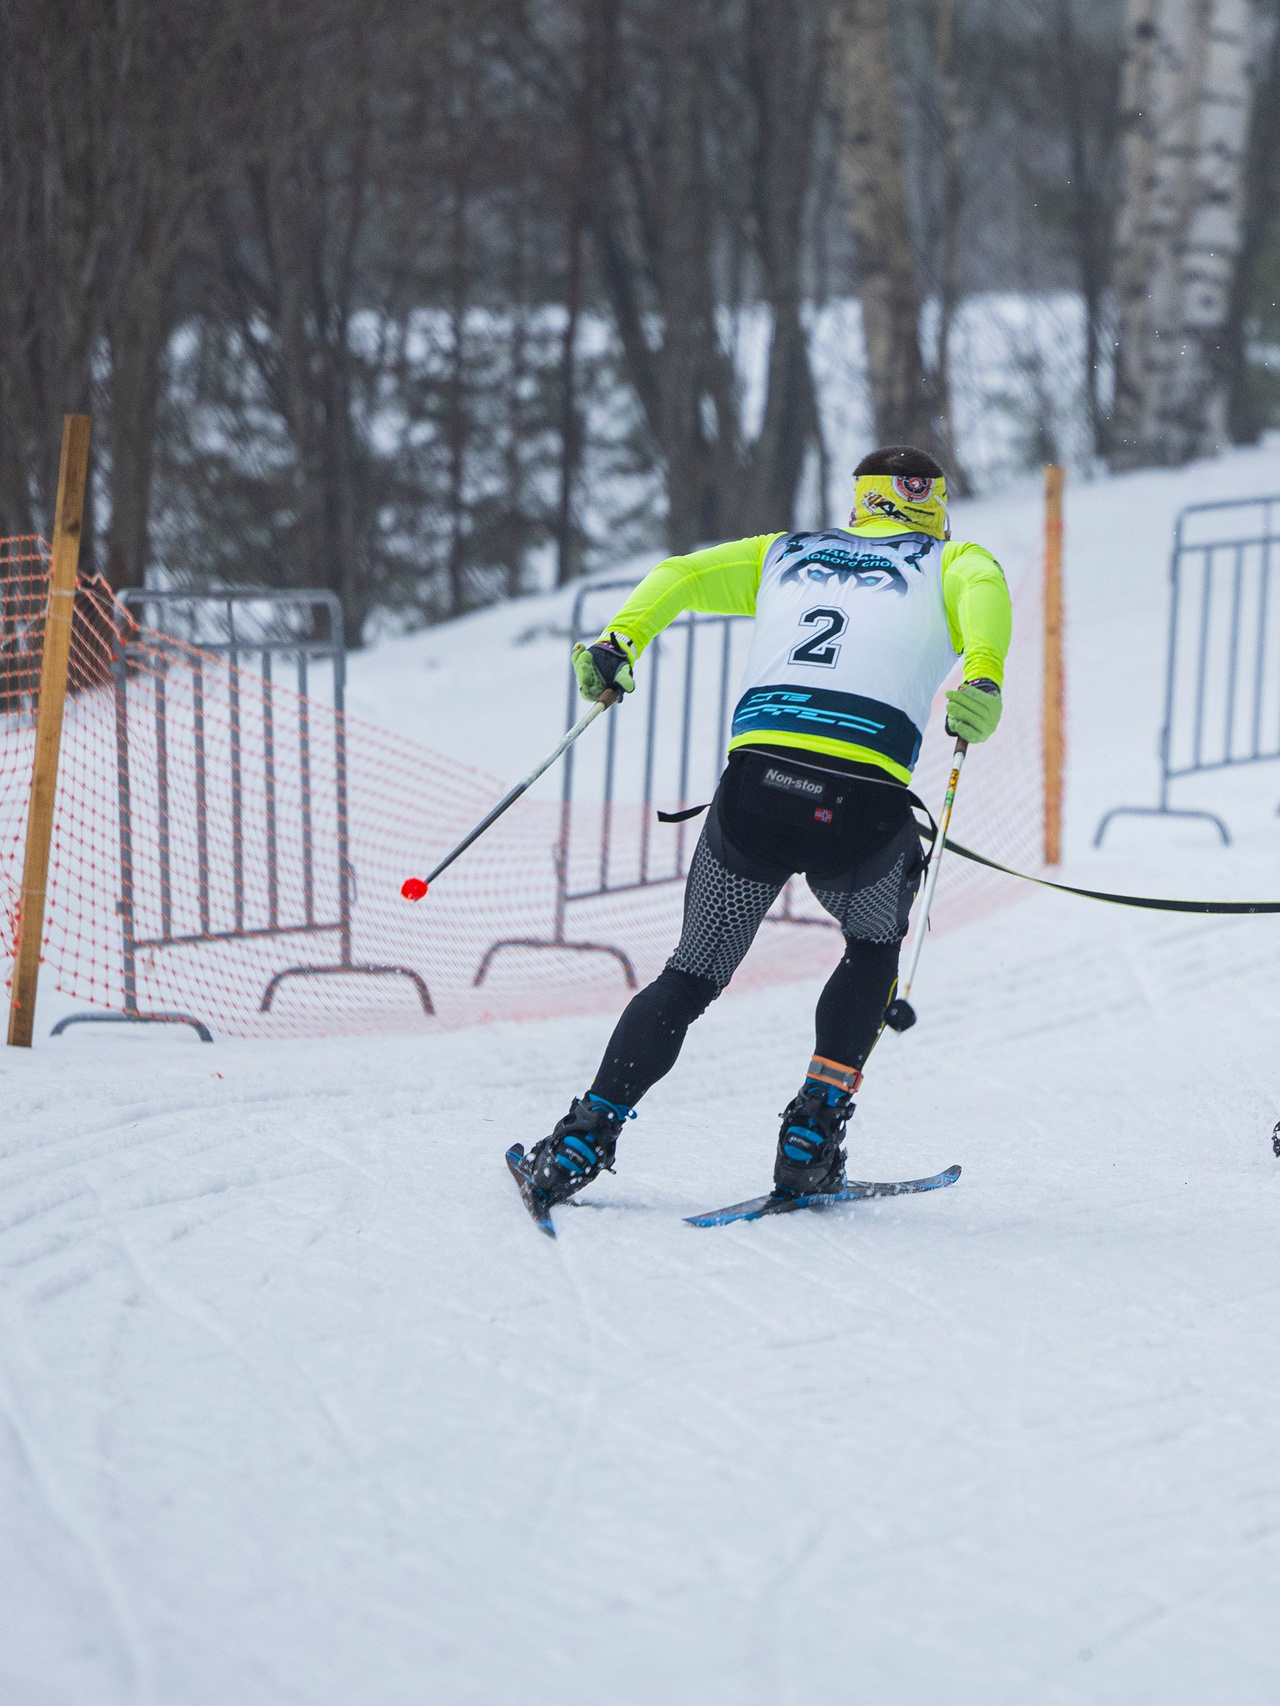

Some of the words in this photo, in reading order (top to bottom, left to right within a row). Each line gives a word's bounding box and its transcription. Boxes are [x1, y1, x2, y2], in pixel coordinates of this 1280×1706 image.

[782, 551, 858, 567] ЕДОВОГО
[861, 560, 917, 569] СПОРА
[787, 605, 850, 669] 2
[765, 768, 824, 794] Non-stop
